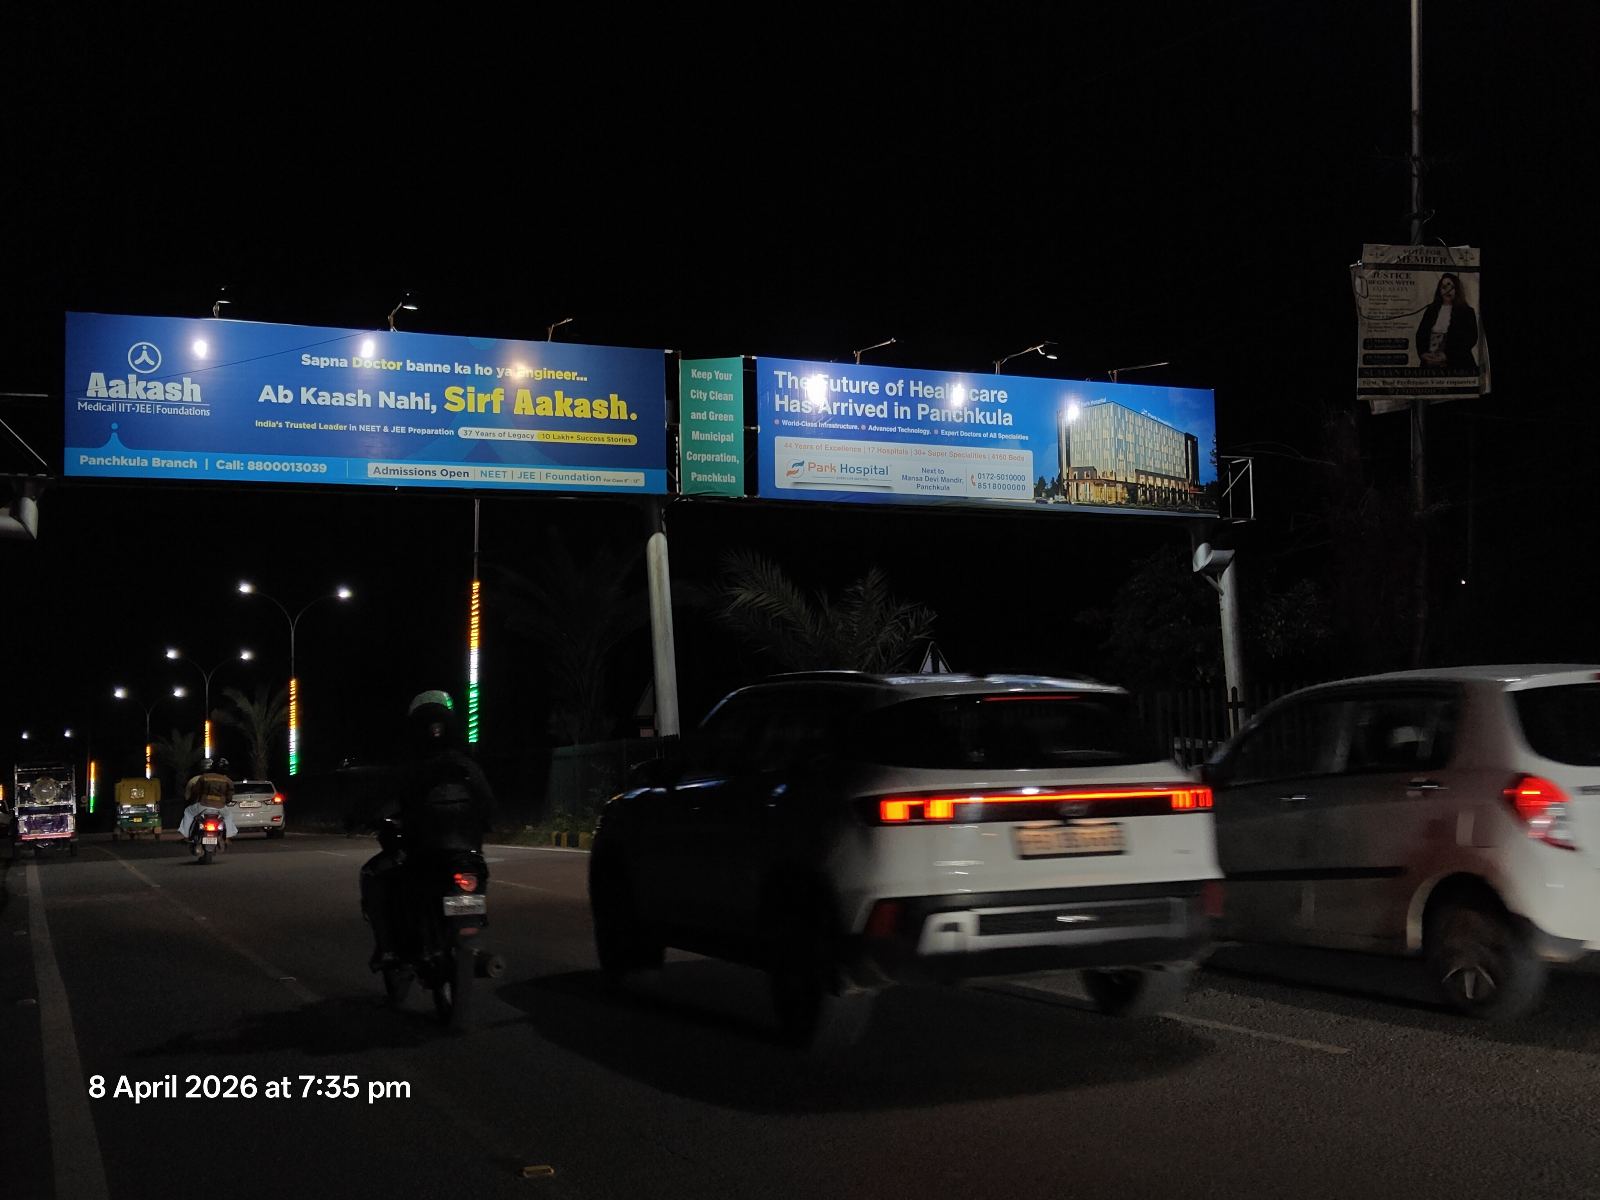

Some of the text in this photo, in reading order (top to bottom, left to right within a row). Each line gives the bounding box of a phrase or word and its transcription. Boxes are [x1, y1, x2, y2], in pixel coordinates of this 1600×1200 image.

[1373, 272, 1411, 280] JUSTICE
[301, 353, 348, 369] Sapna
[352, 356, 403, 371] Doctor
[406, 359, 451, 374] banne
[454, 362, 471, 375] ka
[475, 363, 493, 376] ho
[496, 367, 514, 379] ya
[691, 368, 733, 381] Keep Your
[86, 372, 201, 402] Aakash
[773, 370, 809, 390] The
[885, 380, 905, 397] of
[690, 389, 734, 402] City Clean
[78, 401, 211, 417] Medical IIT-JEE Foundations
[258, 384, 638, 421] Ab Kaash Nahi, Sirf Aakash.
[691, 410, 734, 422] and Green
[774, 394, 1014, 426] Has Arrived in Panchkula
[255, 420, 455, 437] India's Trusted Leader in NEET & JEE Preparation
[463, 429, 473, 437] 37
[474, 430, 496, 438] Years
[508, 431, 535, 440] Legacy
[781, 419, 818, 428] World-Class
[868, 425, 897, 434] Advanced
[982, 431, 989, 439] of
[576, 434, 605, 442] Success
[606, 435, 632, 444] Stories
[691, 430, 734, 443] Municipal
[79, 454, 328, 473] Panchkula Branch Call: 8800013039
[686, 451, 740, 465] Corporation,
[373, 465, 470, 481] Admissions Open
[480, 469, 508, 480] NEET
[516, 470, 536, 480] JEE
[545, 471, 602, 482] Foundation
[807, 462, 889, 478] Park Hospital
[936, 467, 945, 475] to
[691, 471, 736, 484] Panchkula
[923, 475, 940, 483] Devi
[977, 472, 1026, 482] 0172-5010000
[916, 483, 950, 492] Panchkula
